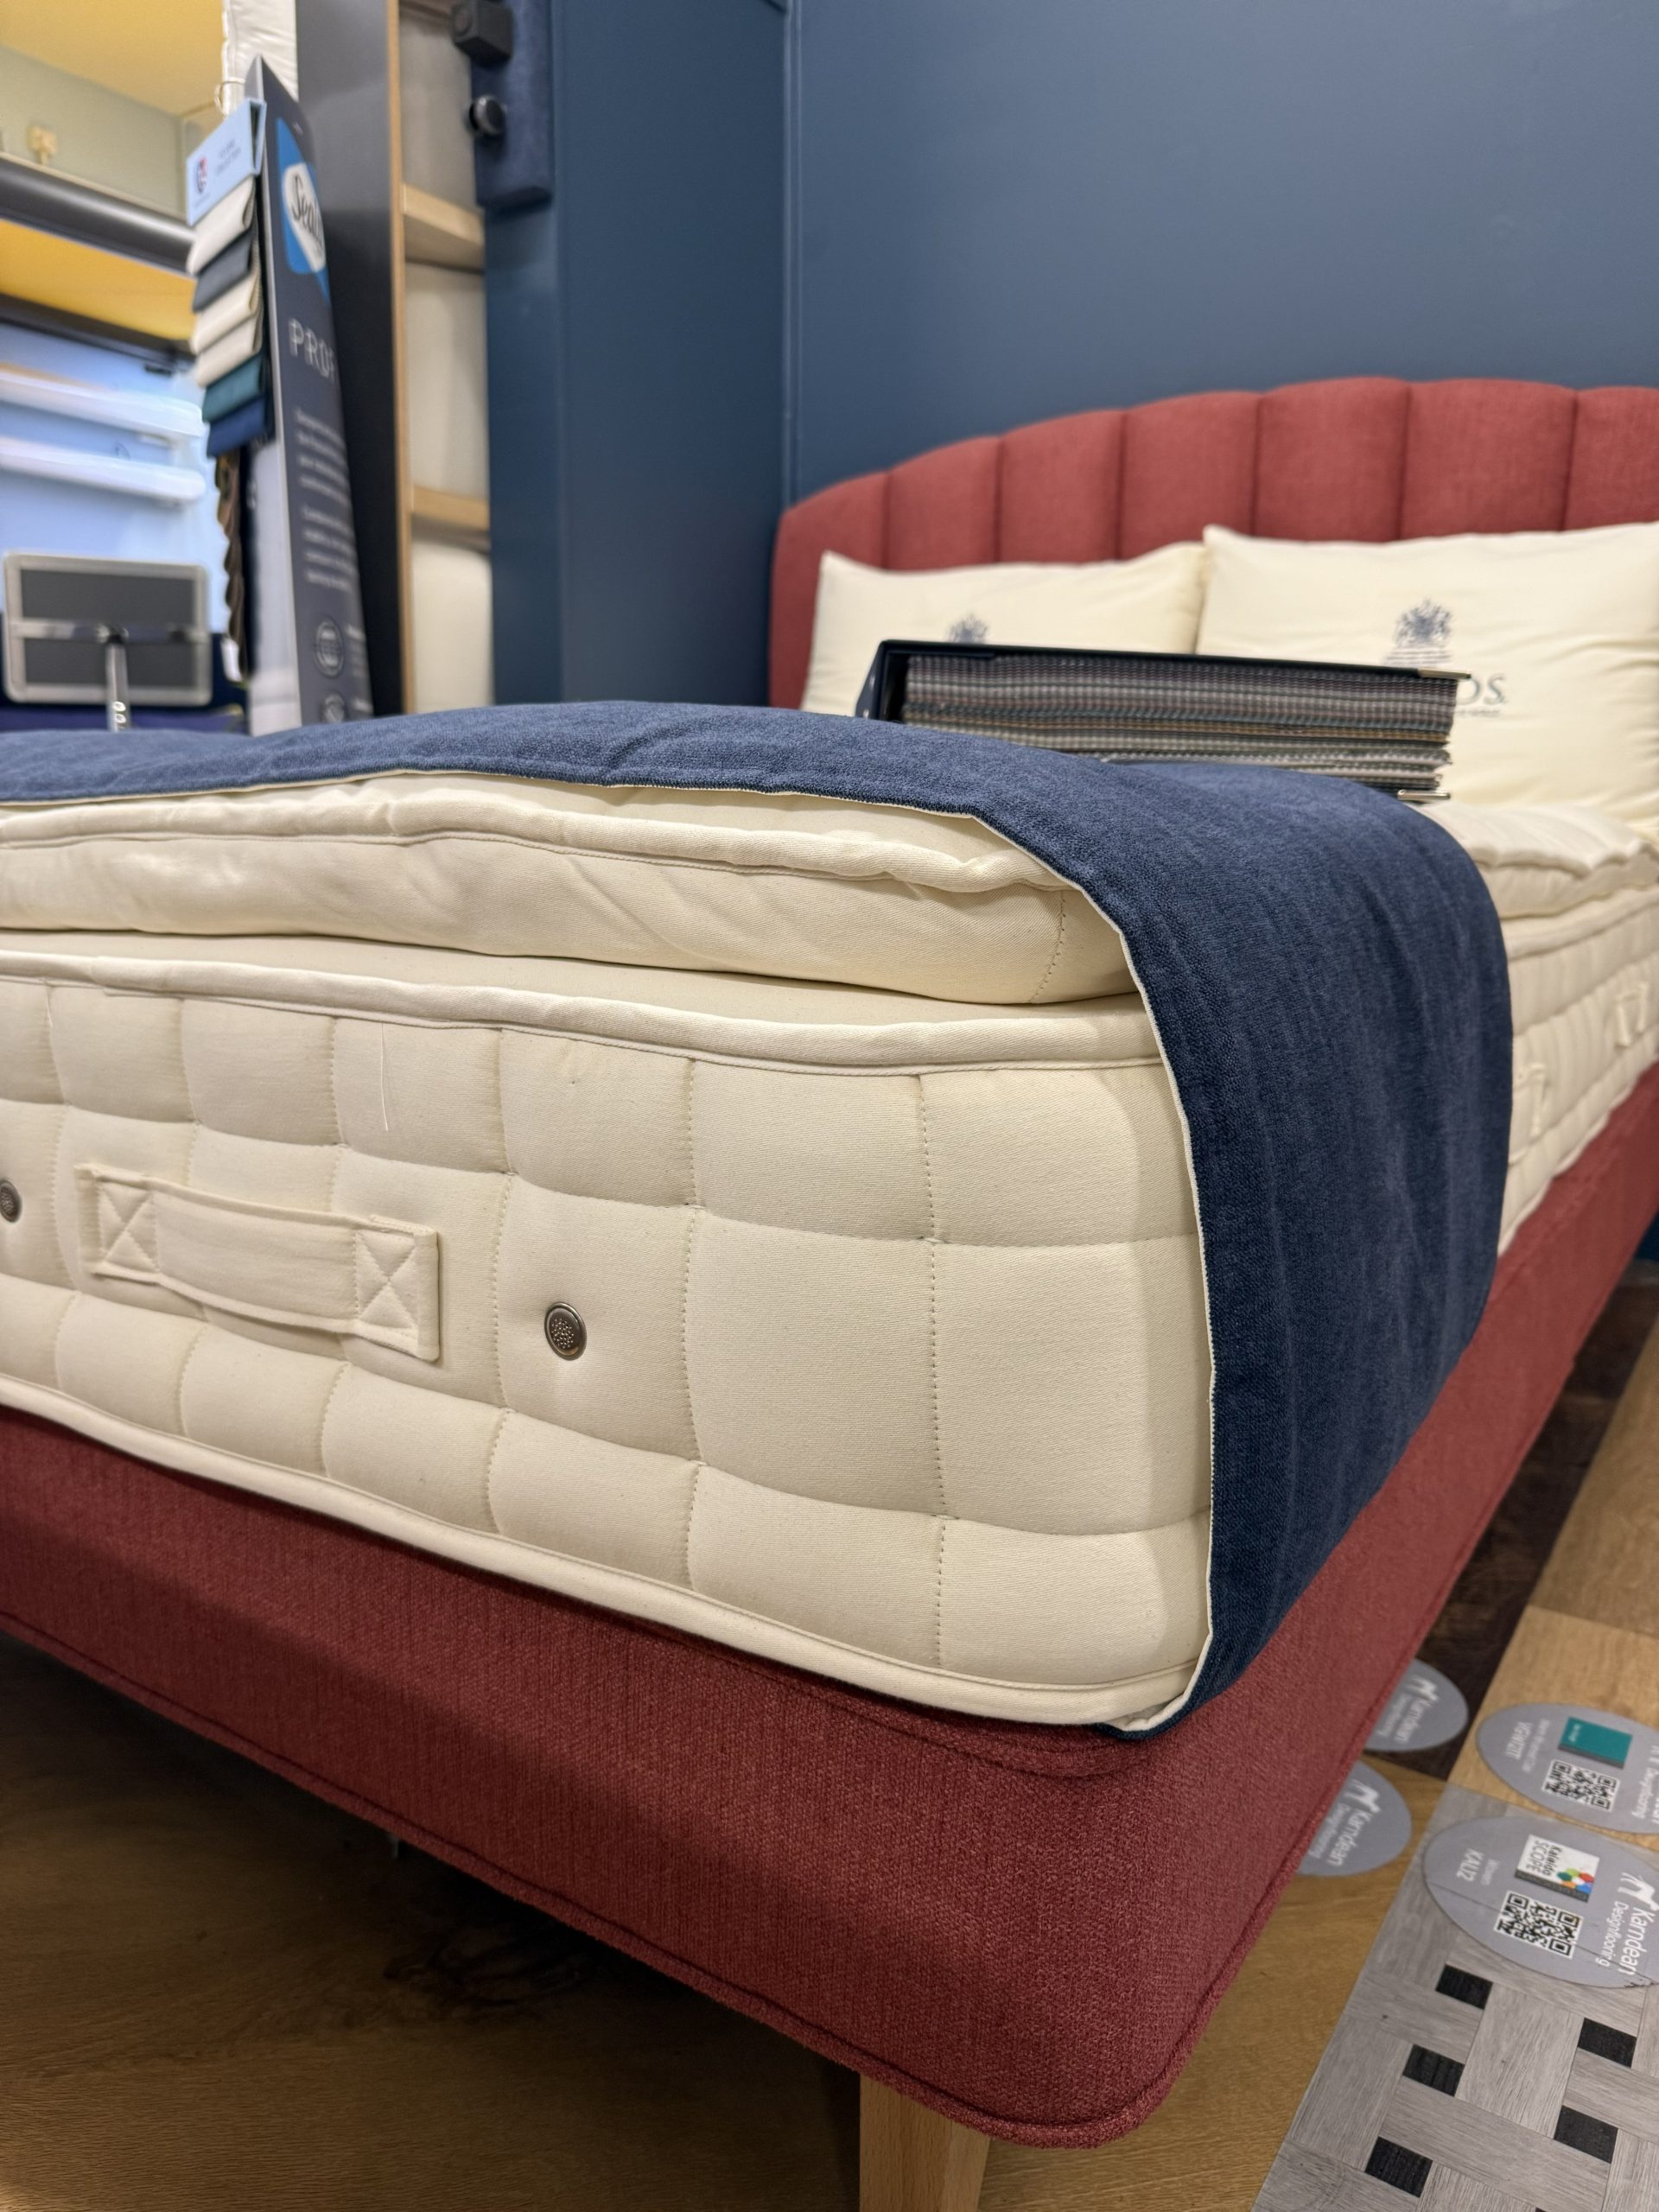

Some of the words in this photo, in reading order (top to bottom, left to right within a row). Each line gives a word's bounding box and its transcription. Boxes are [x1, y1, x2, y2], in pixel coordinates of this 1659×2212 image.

[1326, 1808, 1373, 1866] Karndean
[1525, 1839, 1550, 1874] SCOPE
[1541, 1843, 1563, 1877] Kaleido
[1594, 1900, 1630, 1967] Designflooring
[1617, 1906, 1656, 1975] Karndean
